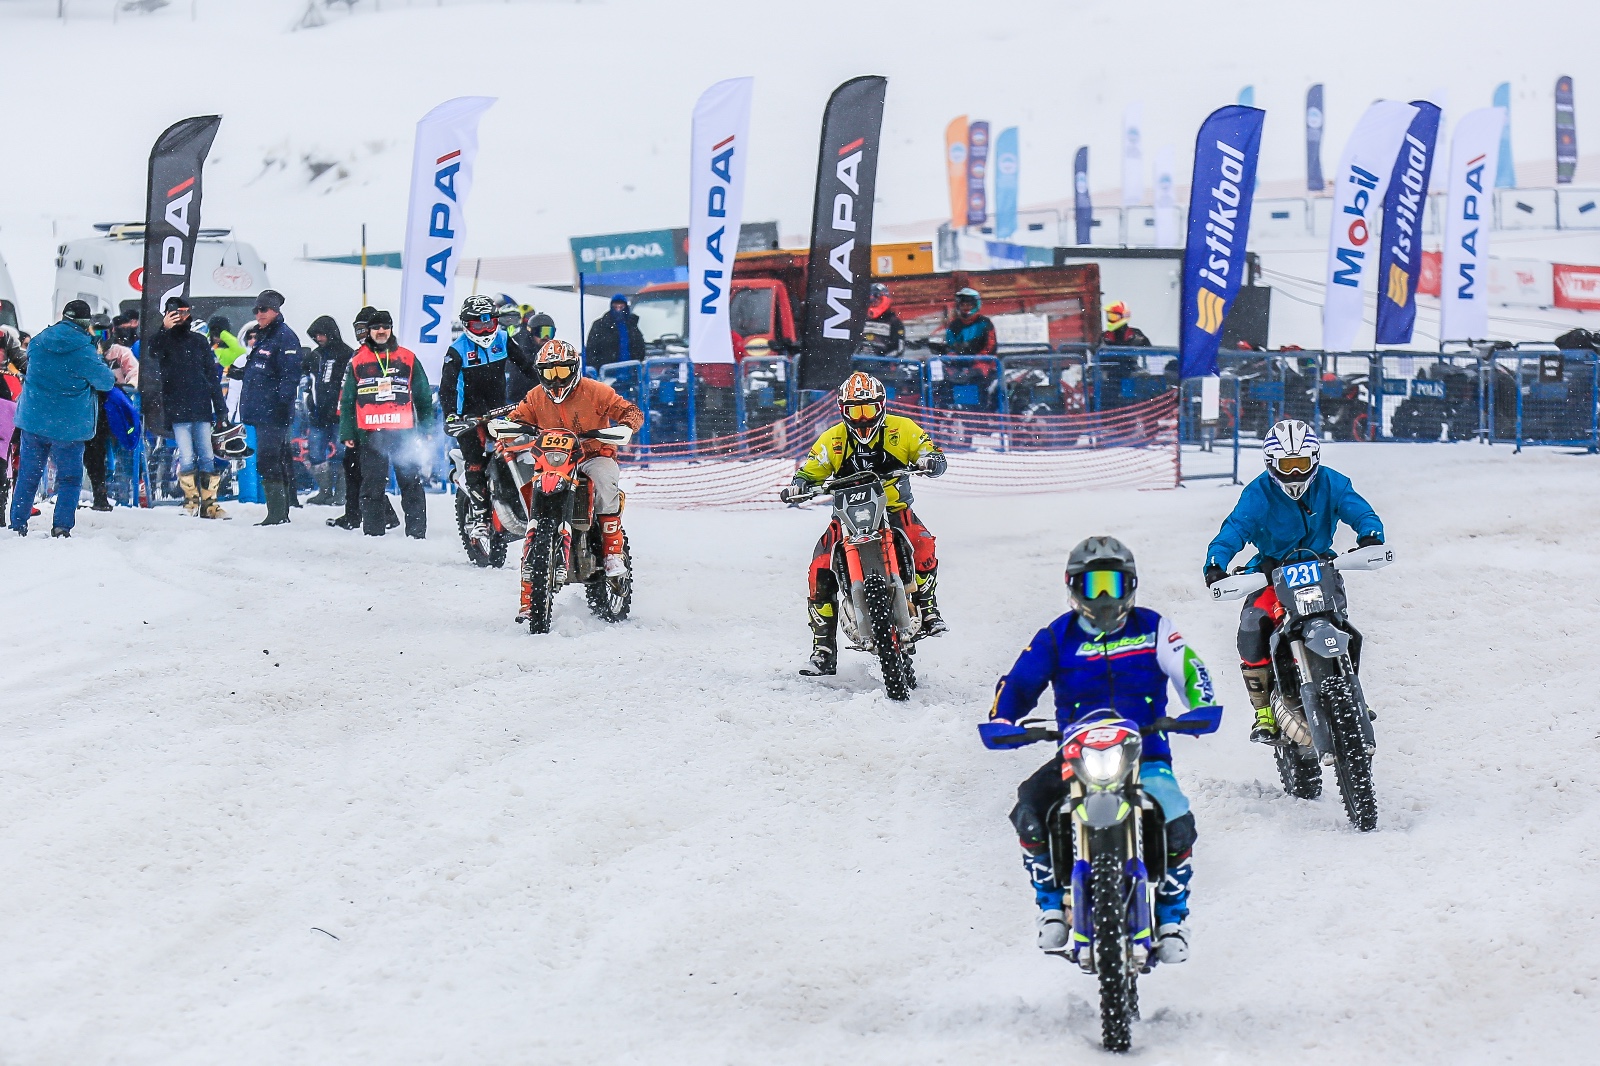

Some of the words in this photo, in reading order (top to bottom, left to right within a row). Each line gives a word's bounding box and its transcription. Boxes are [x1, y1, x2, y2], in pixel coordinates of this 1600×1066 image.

[419, 152, 461, 344] MAPA
[580, 242, 665, 263] BELLONA
[700, 137, 735, 315] MAPA
[823, 141, 864, 340] MAPA
[1199, 140, 1245, 289] istikbal
[1333, 165, 1380, 288] Mobil
[1392, 132, 1427, 265] istikbal
[1458, 156, 1486, 299] MAPA
[365, 413, 401, 425] HAKEM
[545, 437, 569, 447] 549
[849, 491, 867, 503] 241
[1286, 563, 1321, 588] 231
[1083, 729, 1120, 745] 55
